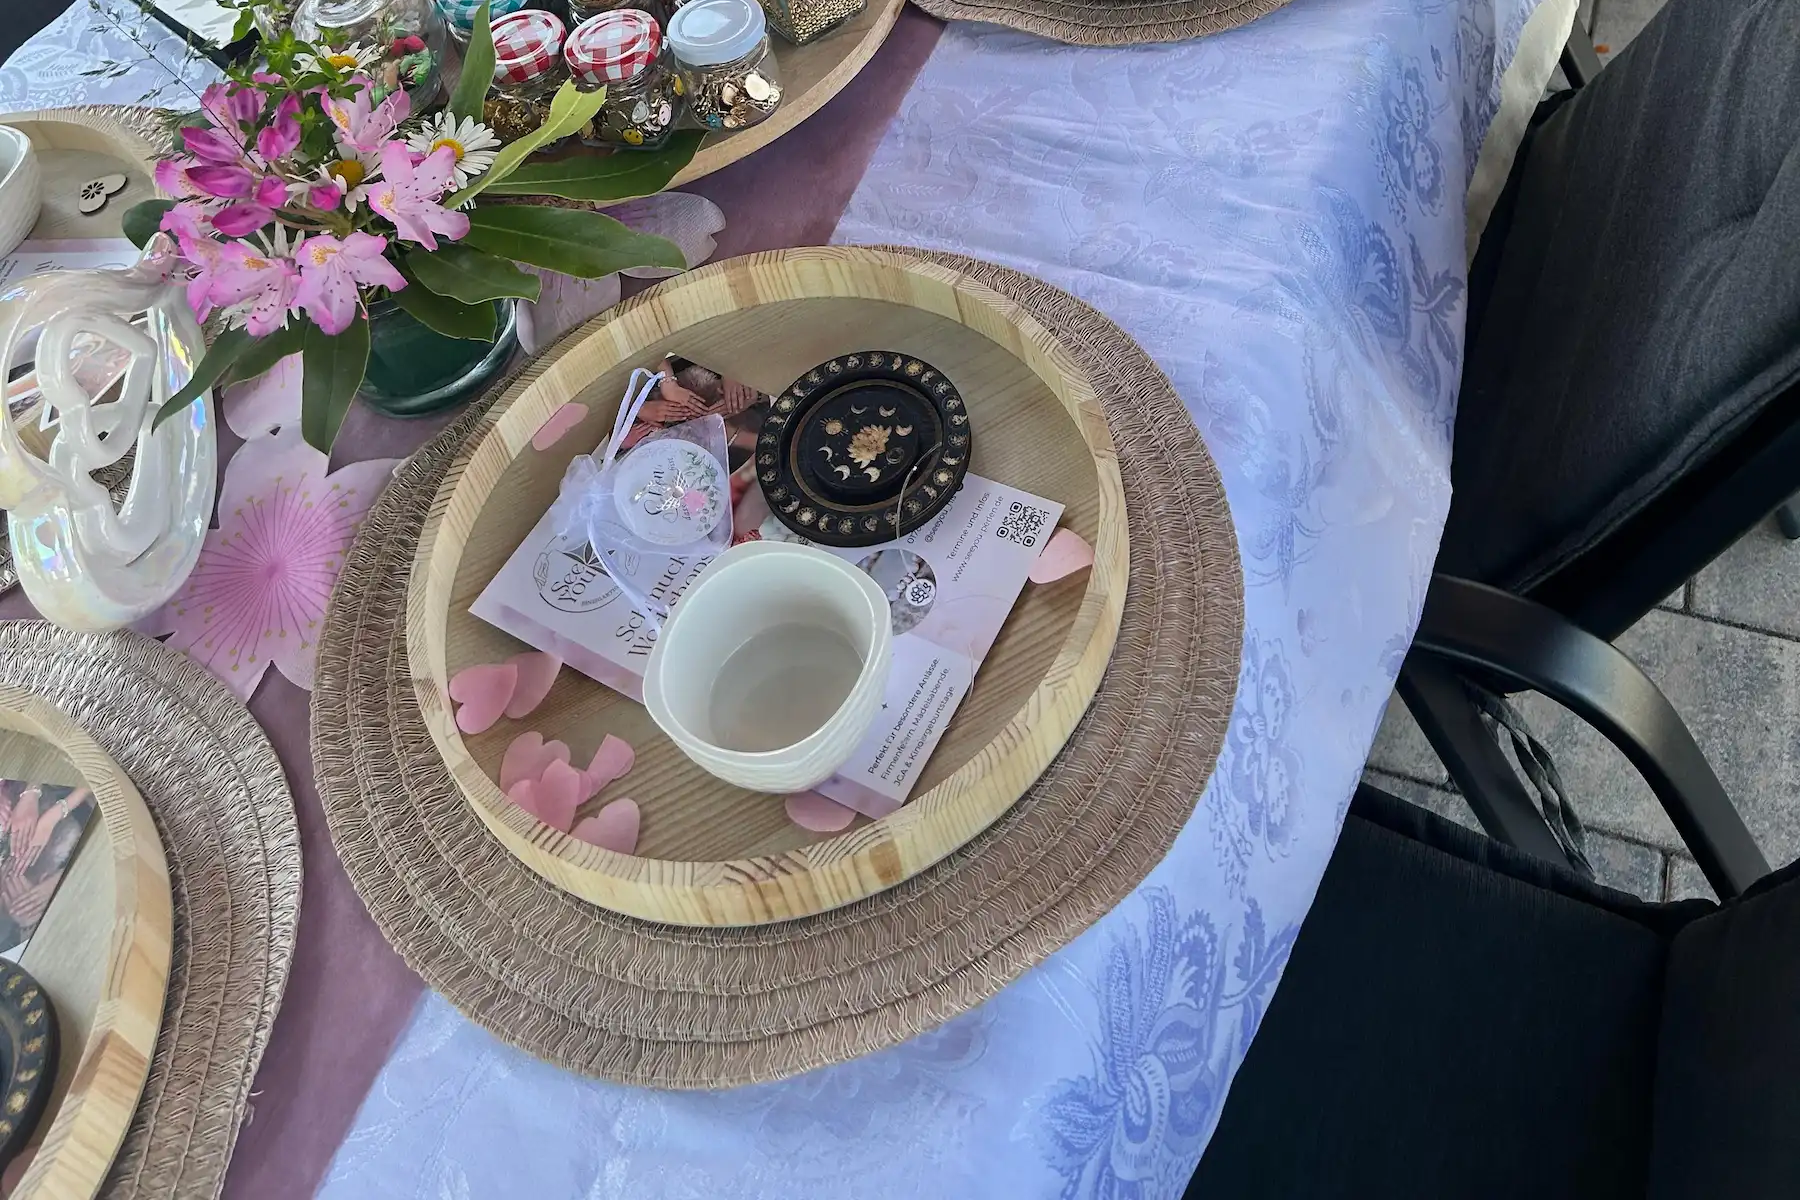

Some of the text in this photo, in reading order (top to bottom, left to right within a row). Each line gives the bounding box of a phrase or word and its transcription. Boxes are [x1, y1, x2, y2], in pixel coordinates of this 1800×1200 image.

[946, 530, 969, 561] Termine
[967, 511, 979, 529] und
[550, 563, 586, 594] See
[558, 567, 597, 603] You
[868, 743, 890, 774] Perfekt
[893, 689, 922, 732] besondere
[893, 769, 908, 786] JGA
